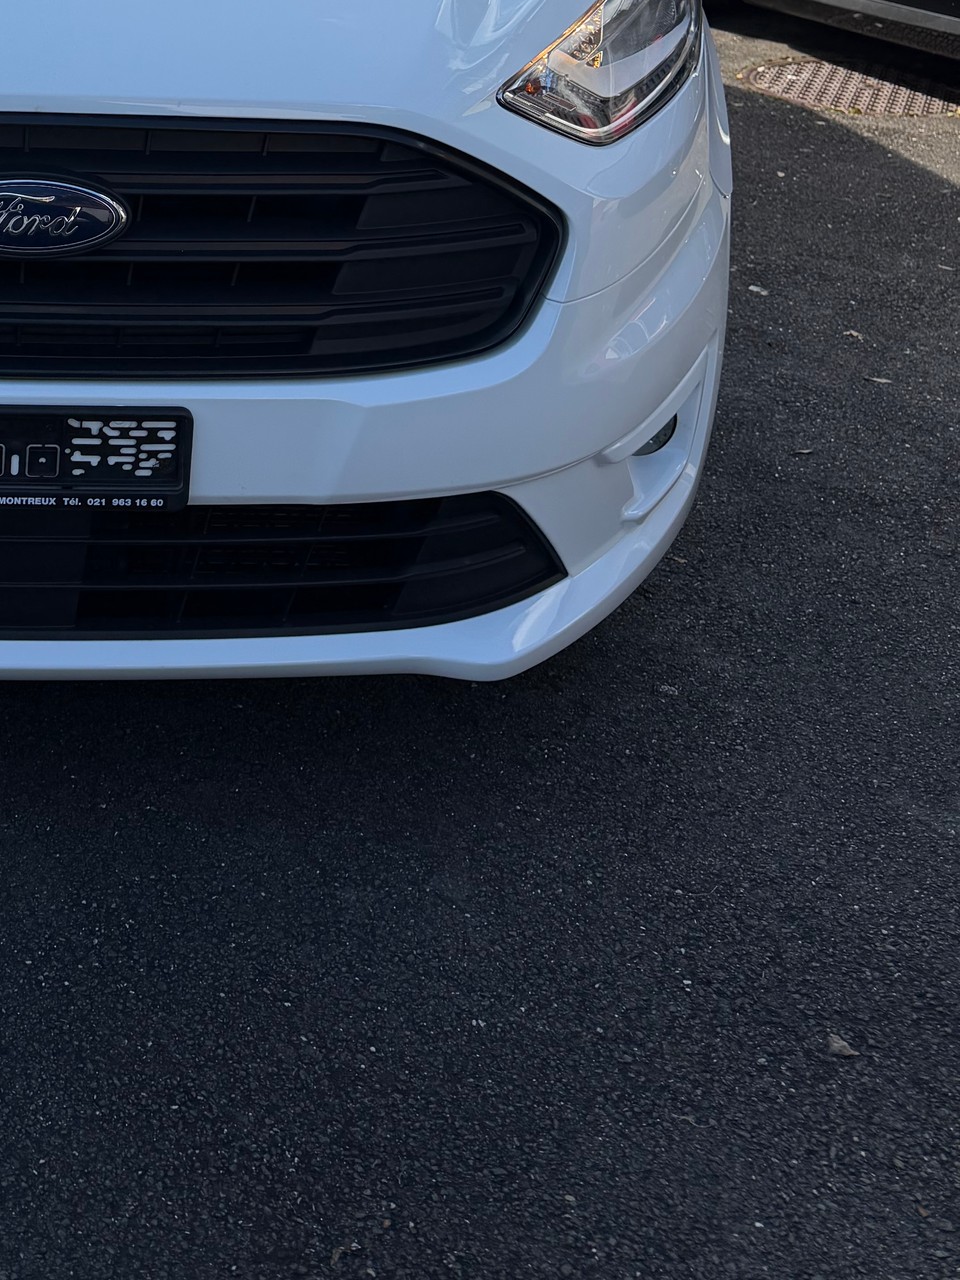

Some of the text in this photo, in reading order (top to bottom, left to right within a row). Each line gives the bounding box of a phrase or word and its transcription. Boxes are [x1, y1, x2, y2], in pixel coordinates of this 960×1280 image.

[62, 497, 82, 506] Tél.
[87, 498, 106, 506] 021
[112, 498, 132, 507] 963
[135, 499, 148, 507] 16
[150, 499, 164, 507] 60
